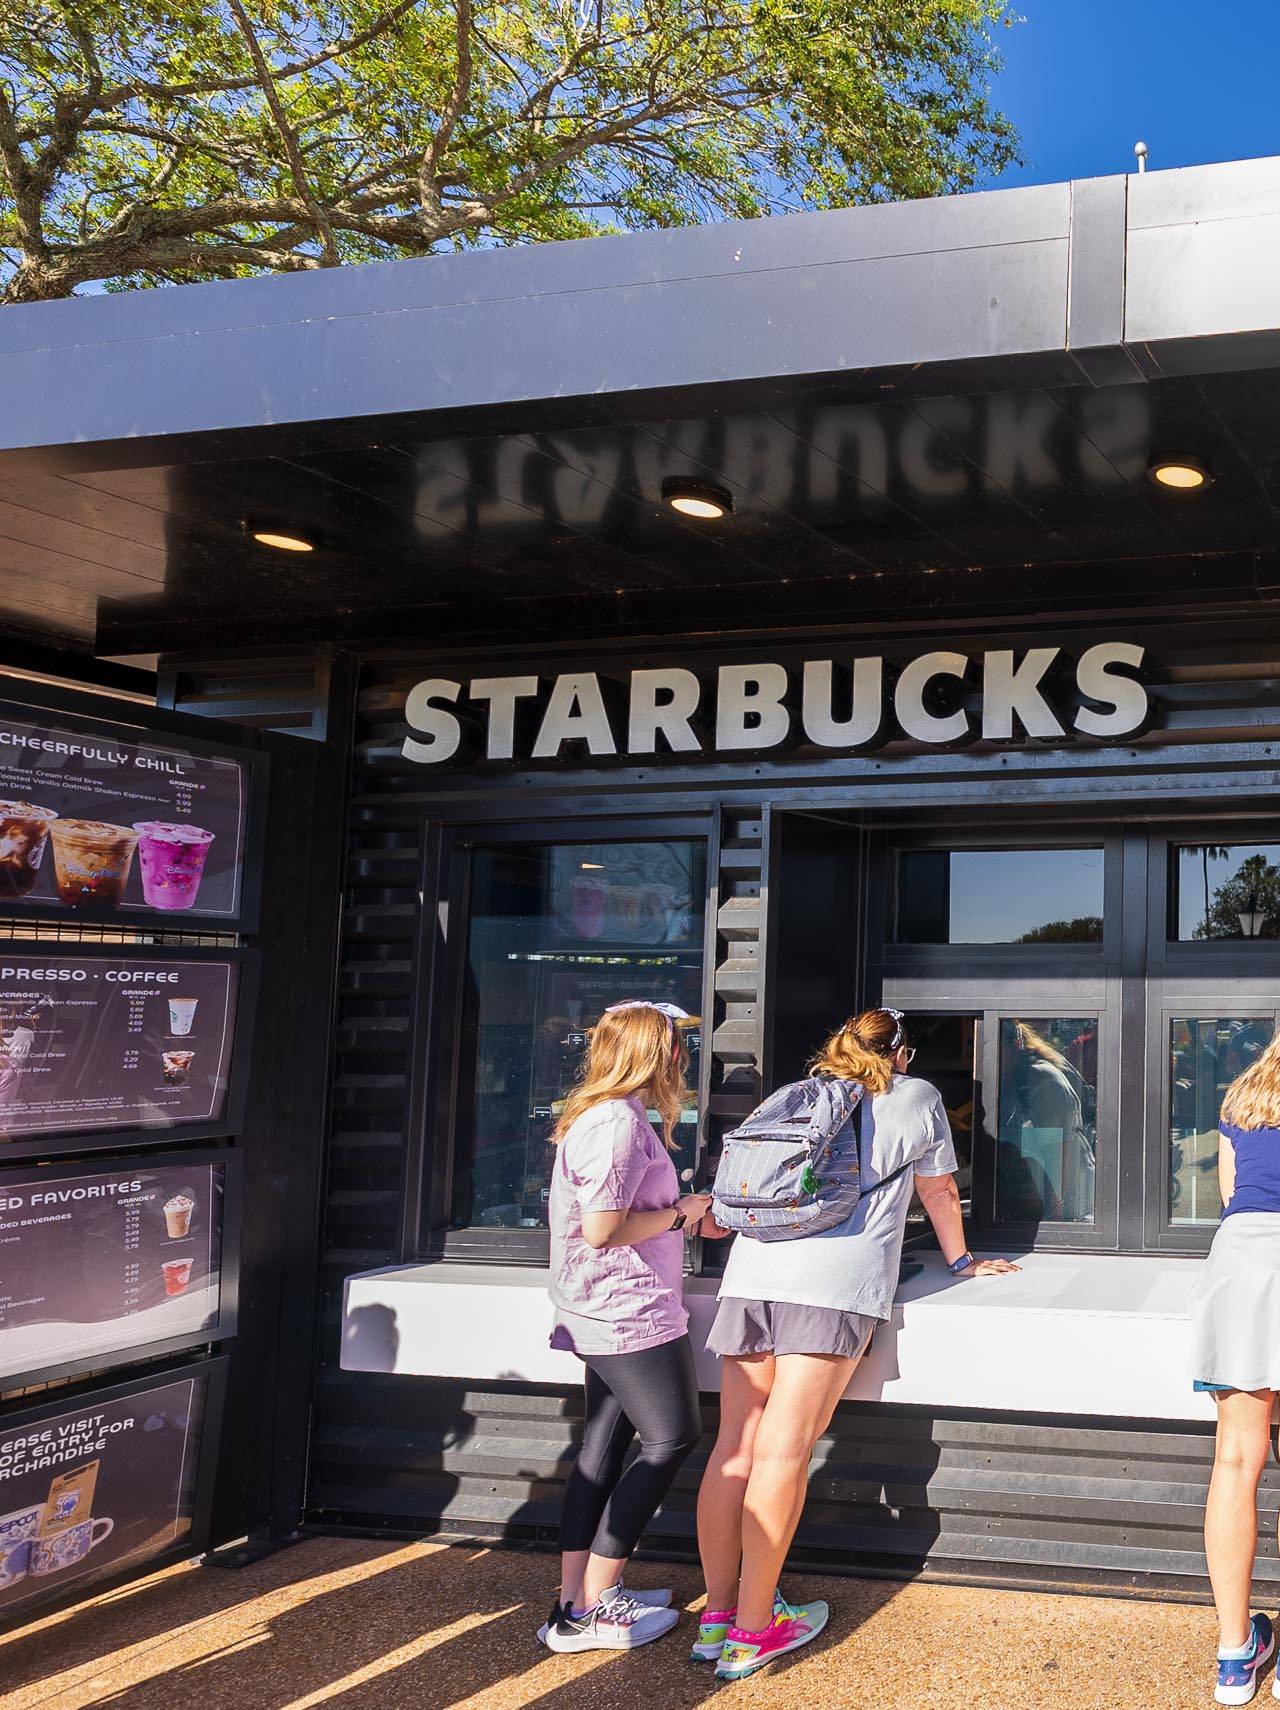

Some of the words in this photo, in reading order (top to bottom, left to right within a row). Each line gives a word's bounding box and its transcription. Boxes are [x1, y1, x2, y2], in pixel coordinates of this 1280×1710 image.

[401, 641, 1147, 764] STARBUCKS
[0, 732, 128, 764] CHEERFULLY
[135, 757, 185, 775] CHILL
[0, 773, 31, 783] oasted
[33, 777, 60, 787] Vanilla
[124, 791, 156, 801] Espresso
[8, 766, 33, 775] Sweet
[36, 770, 62, 779] Cream
[64, 775, 82, 783] Cold
[10, 782, 32, 790] Drink
[1, 967, 87, 981] PRESSO
[105, 971, 179, 983] COFFEE
[0, 1197, 23, 1211] ED
[31, 1180, 142, 1206] FAVORITES
[117, 1195, 149, 1205] GRANDE
[20, 1212, 72, 1227] BEVERAGES
[0, 1451, 26, 1467] OF
[32, 1430, 93, 1457] ENTRY
[98, 1418, 135, 1437] FOR
[1, 1430, 52, 1453] EASE
[58, 1415, 104, 1437] VISIT
[0, 1438, 107, 1481] RCHANDISE
